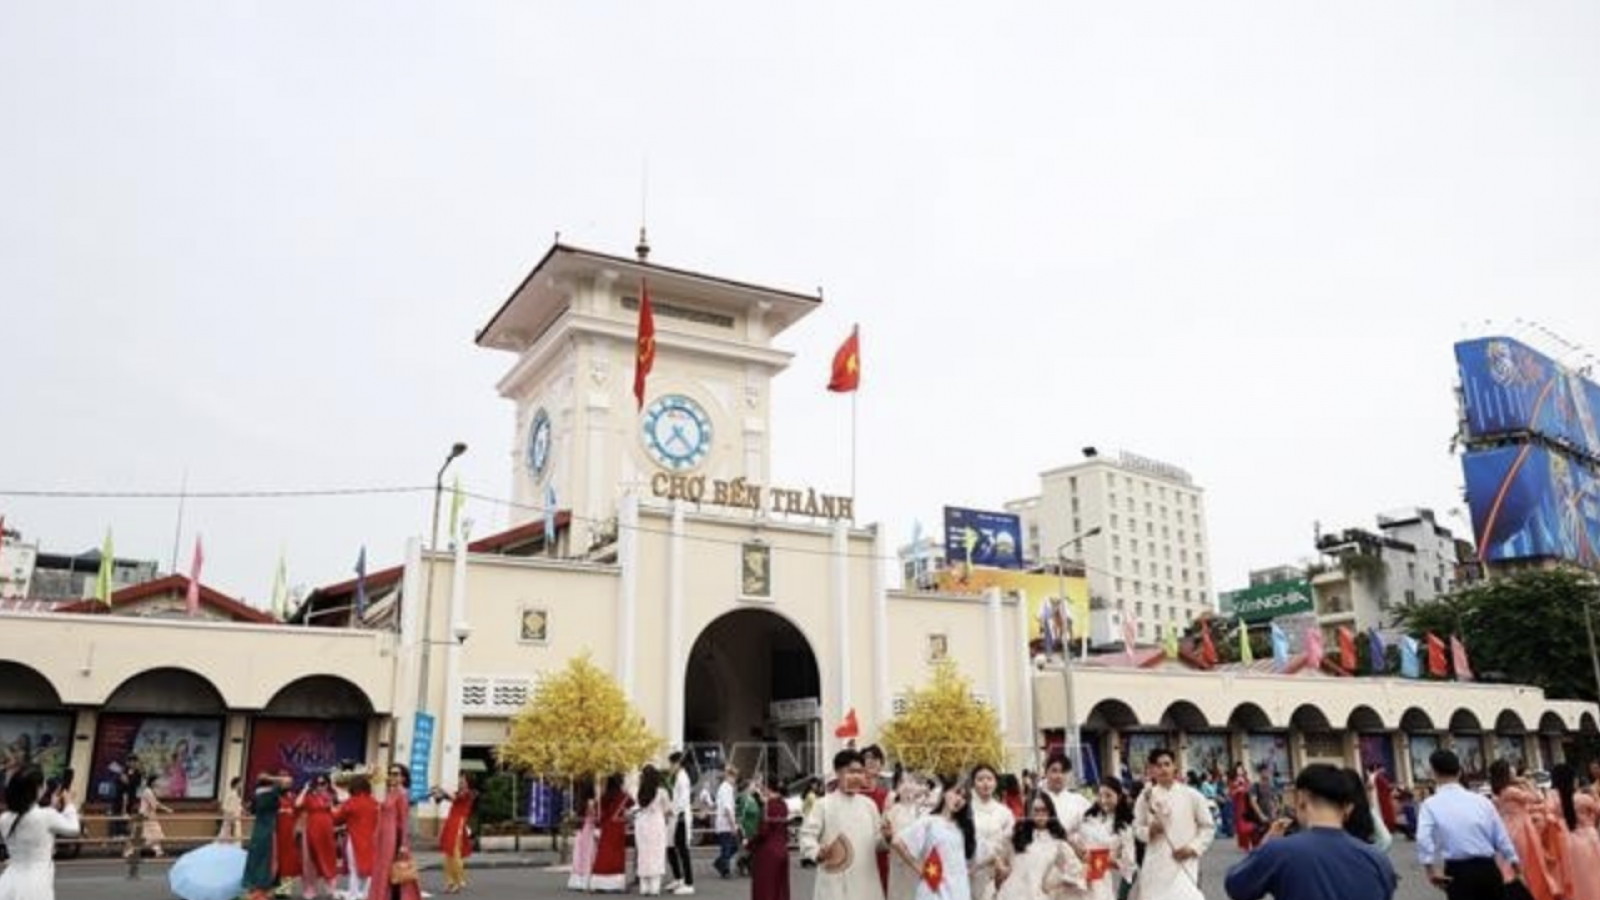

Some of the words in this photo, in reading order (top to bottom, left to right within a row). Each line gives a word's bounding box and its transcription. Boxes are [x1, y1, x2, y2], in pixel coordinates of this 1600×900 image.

[652, 472, 705, 503] CHỢ
[713, 477, 760, 510] BẾN
[770, 486, 853, 519] THÀNH
